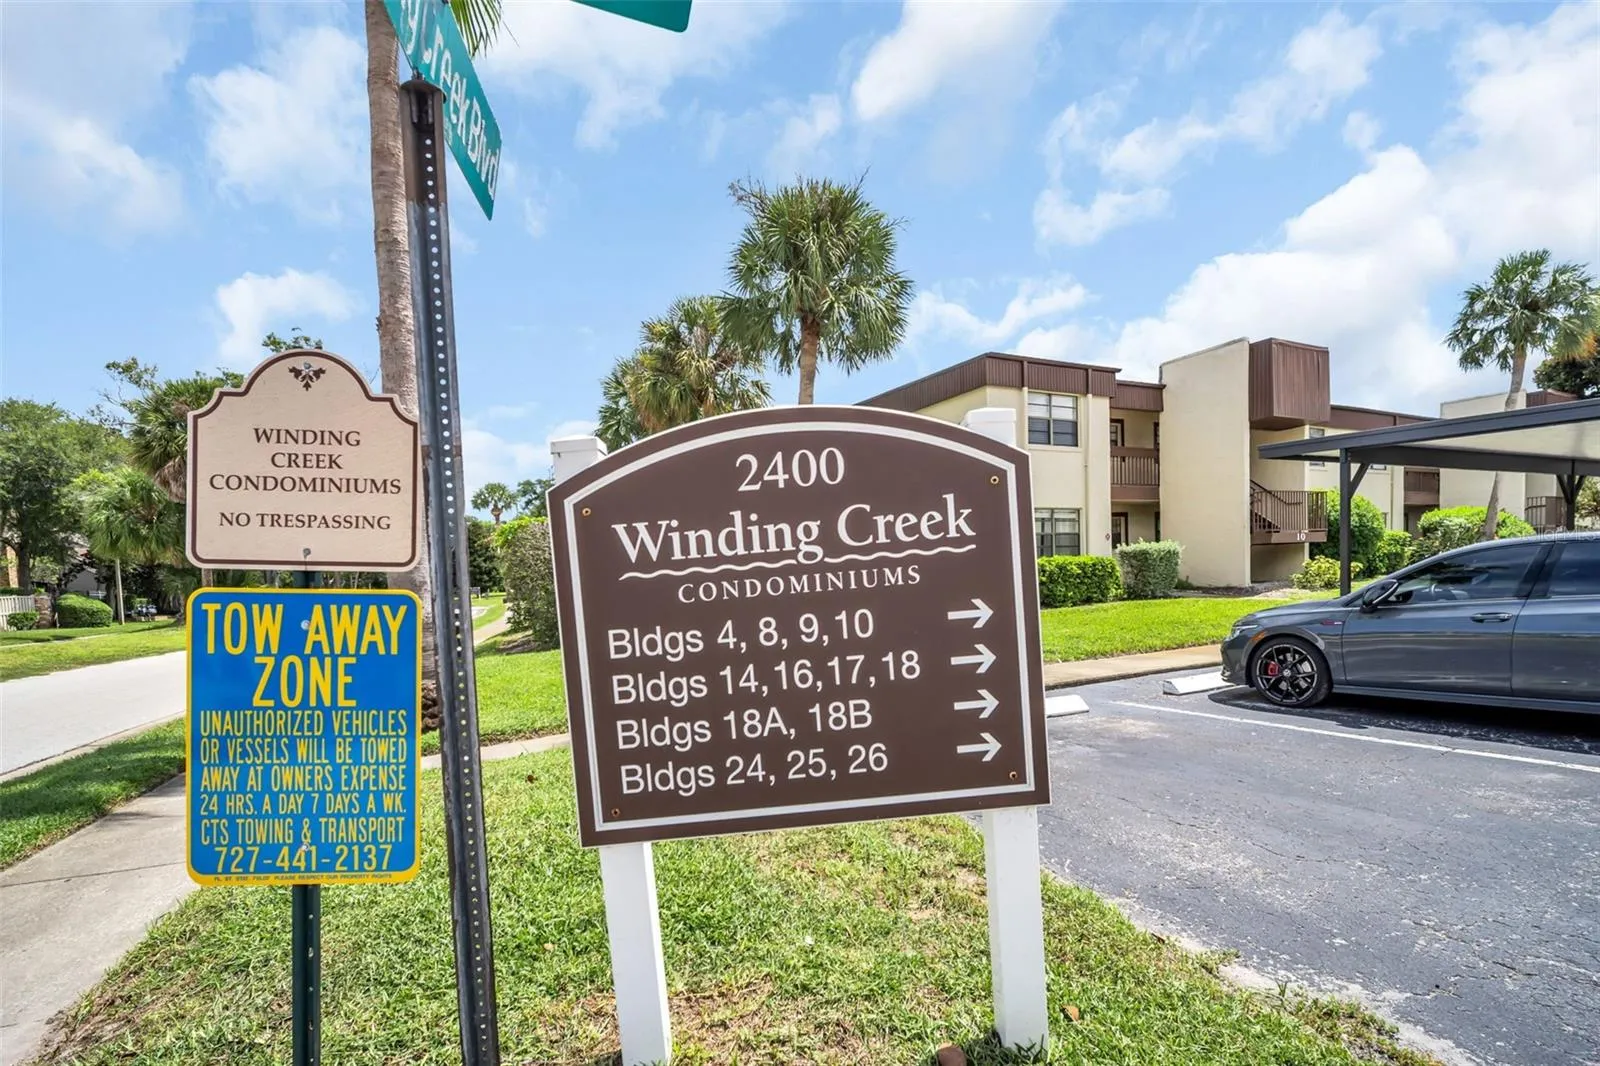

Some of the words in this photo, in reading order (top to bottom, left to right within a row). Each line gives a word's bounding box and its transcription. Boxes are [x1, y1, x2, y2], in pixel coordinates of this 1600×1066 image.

[467, 96, 500, 200] Blvd
[253, 427, 361, 447] WINDING
[271, 452, 344, 470] CREEK
[735, 447, 845, 492] 2400
[209, 474, 402, 495] CONDOMINIUMS
[219, 512, 251, 527] NO
[256, 512, 391, 530] TRESPASSING
[611, 510, 823, 565] Winding
[837, 493, 977, 548] Creek
[1297, 533, 1306, 541] 10
[678, 564, 921, 603] CONDOMINIUMS
[201, 602, 284, 655] TOW
[304, 603, 408, 656] AWAY
[608, 625, 704, 662] Bldgs
[717, 620, 747, 654] 4,
[758, 616, 788, 650] 8,
[799, 613, 829, 647] 9,
[835, 609, 874, 640] 10
[252, 655, 357, 708] ZONE
[612, 670, 708, 707] Bldgs
[719, 663, 768, 697] 14,
[774, 658, 822, 691] 16,
[827, 654, 876, 687] 17,
[882, 650, 921, 681] 18
[200, 710, 324, 737] UNAUTHORIZED
[332, 709, 407, 736] VEHICLES
[616, 716, 711, 753] Bldgs
[723, 706, 796, 740] 18A,
[808, 699, 873, 732] 18B
[200, 738, 219, 764] OR
[227, 738, 289, 764] VESSELS
[297, 738, 329, 763] WILL
[336, 738, 353, 763] BE
[361, 737, 407, 763] TOWED
[200, 766, 240, 792] AWAY
[247, 766, 263, 791] AT
[271, 765, 333, 791] OWNERS
[341, 765, 407, 791] EXPENSE
[620, 760, 715, 797] Bldgs
[725, 752, 776, 787] 24,
[786, 748, 837, 782] 25,
[848, 743, 889, 773] 26
[200, 794, 218, 815] 24
[226, 794, 258, 815] HRS.
[262, 795, 271, 814] A
[279, 793, 304, 814] DAY
[311, 793, 319, 813] 7
[326, 793, 360, 814] DAYS
[367, 793, 376, 813] A
[383, 793, 407, 813] WK.
[201, 819, 229, 845] CTS
[236, 818, 293, 844] TOWING
[301, 817, 311, 843] &
[319, 816, 405, 844] TRANSPORT
[214, 844, 393, 873] 727-441-2137
